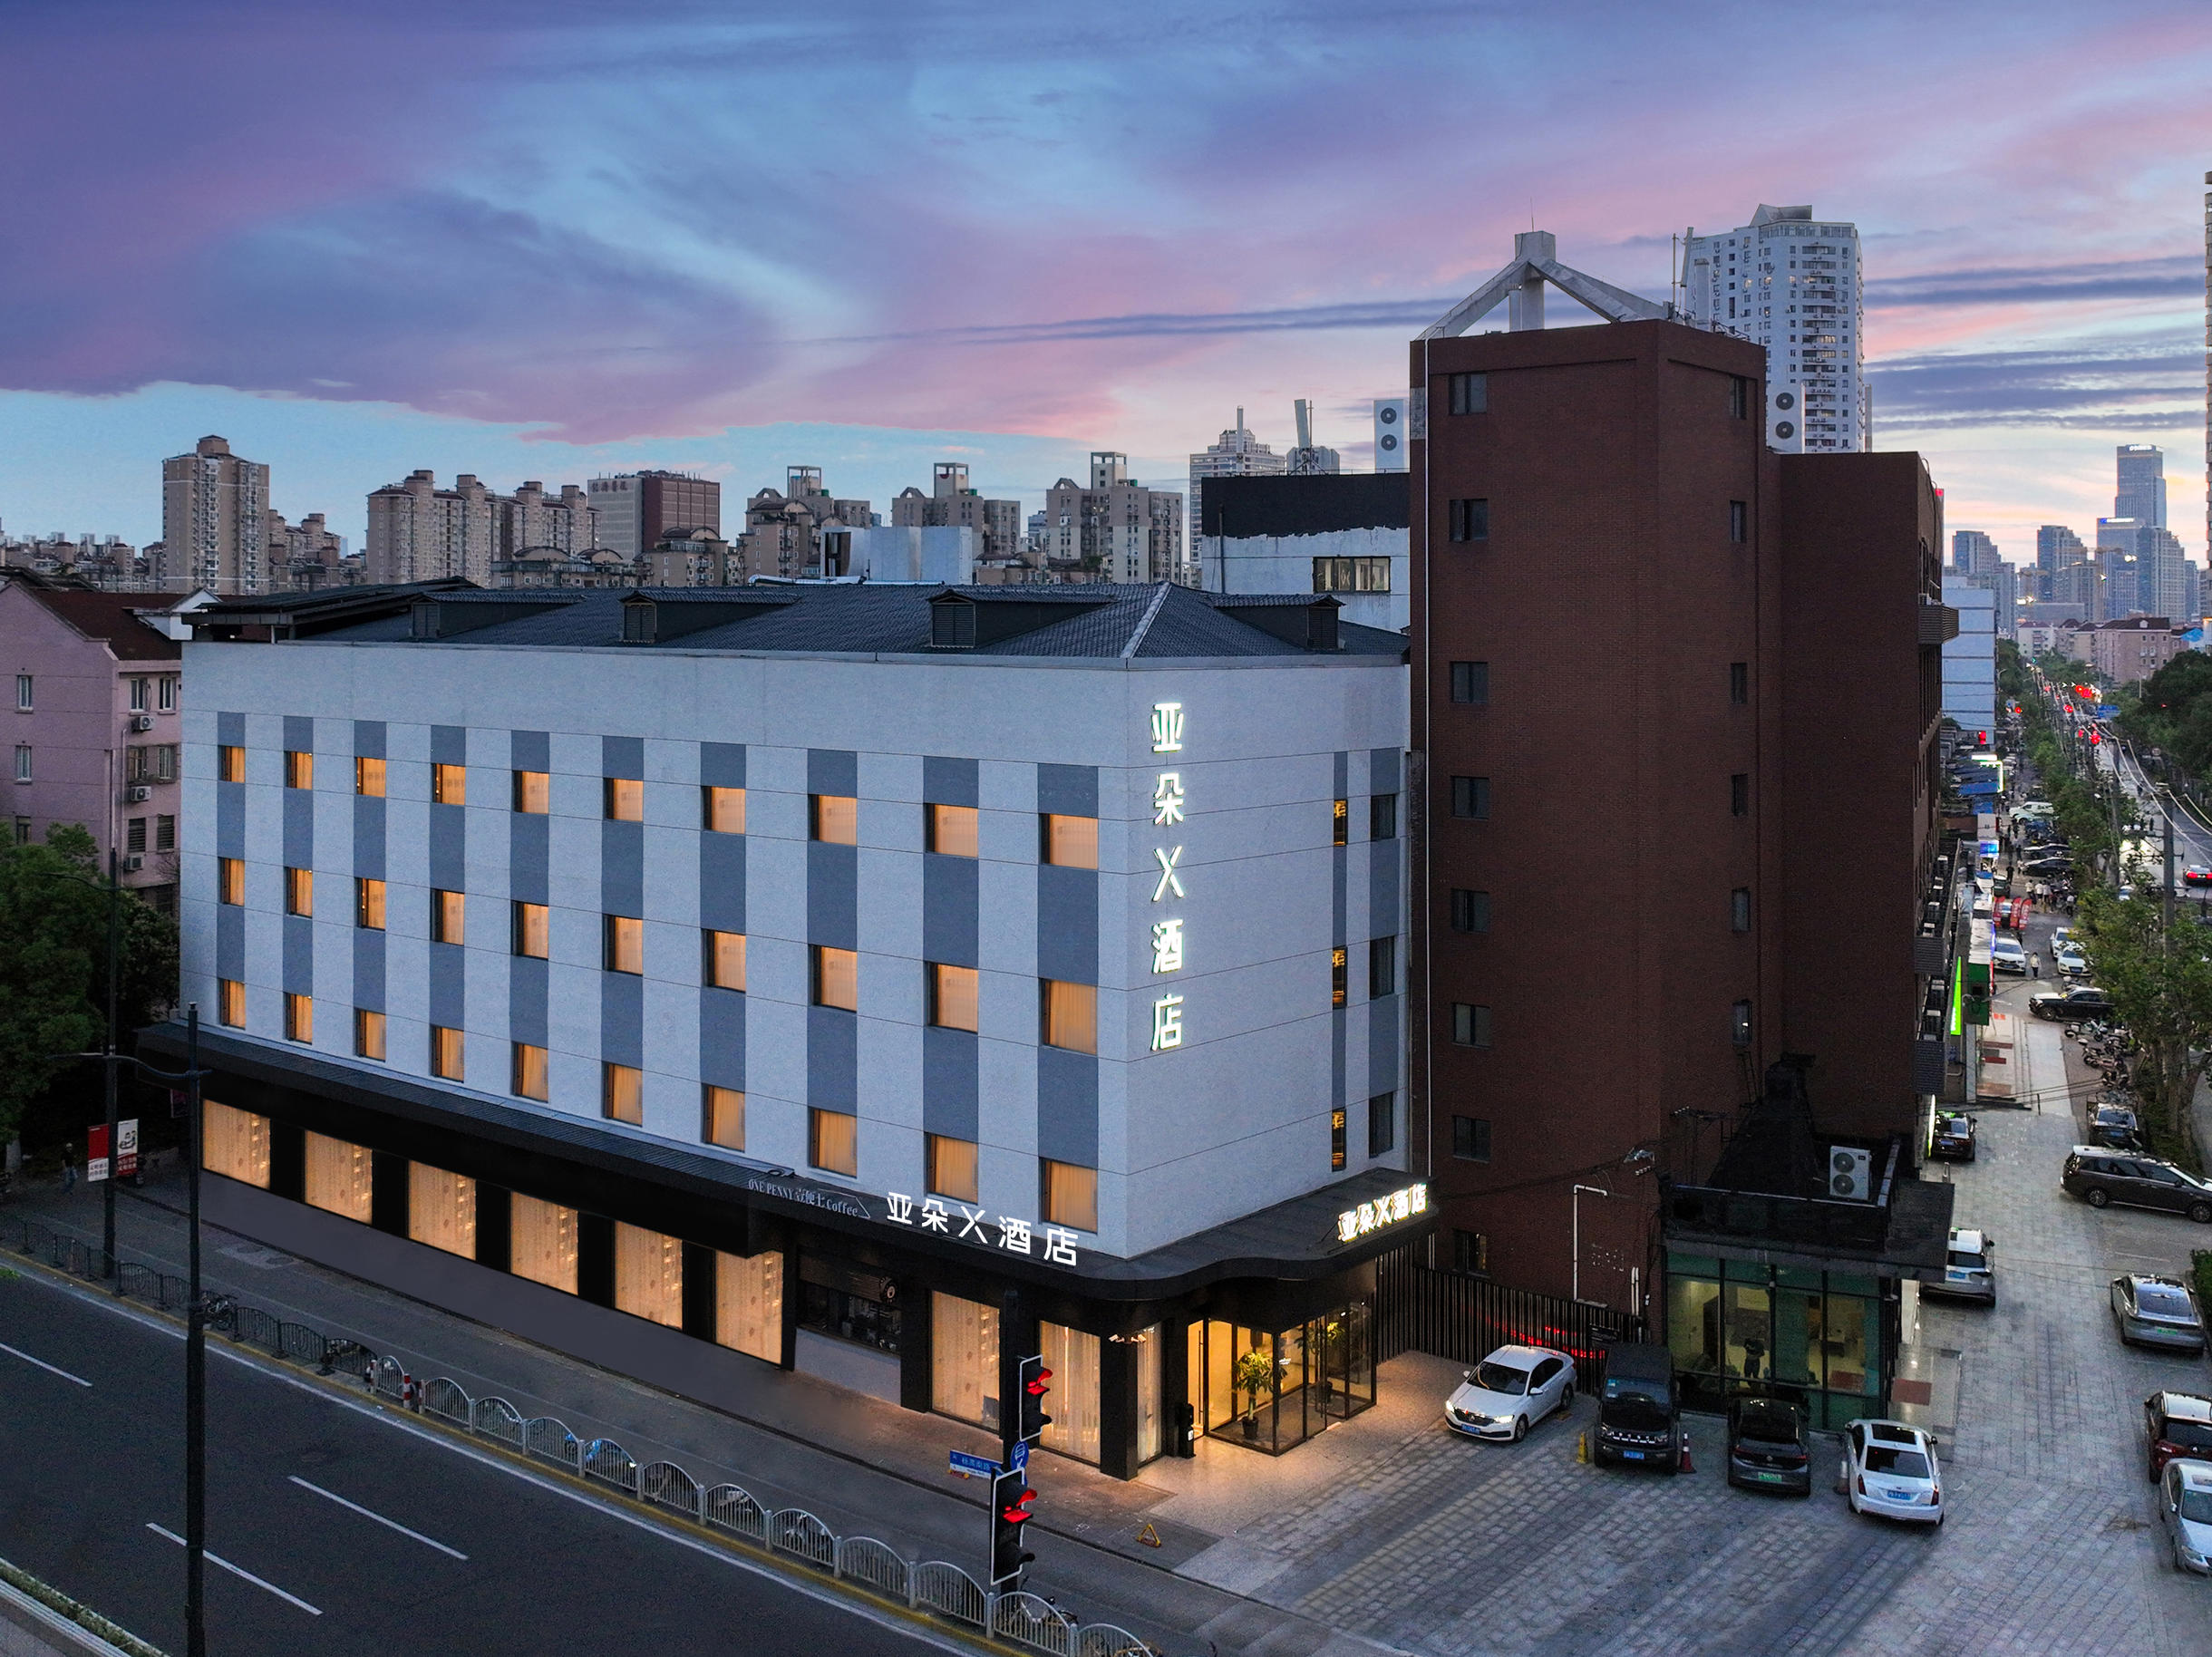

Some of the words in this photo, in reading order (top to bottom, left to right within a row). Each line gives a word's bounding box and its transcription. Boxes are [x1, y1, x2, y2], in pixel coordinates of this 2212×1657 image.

[1150, 703, 1184, 1051] 亚朵X酒店
[748, 1178, 765, 1193] ONE
[766, 1183, 794, 1201] PENNY
[826, 1197, 859, 1217] Coffee
[887, 1191, 1079, 1266] 亚朵X酒店
[1337, 1183, 1427, 1242] 亚朵X酒店
